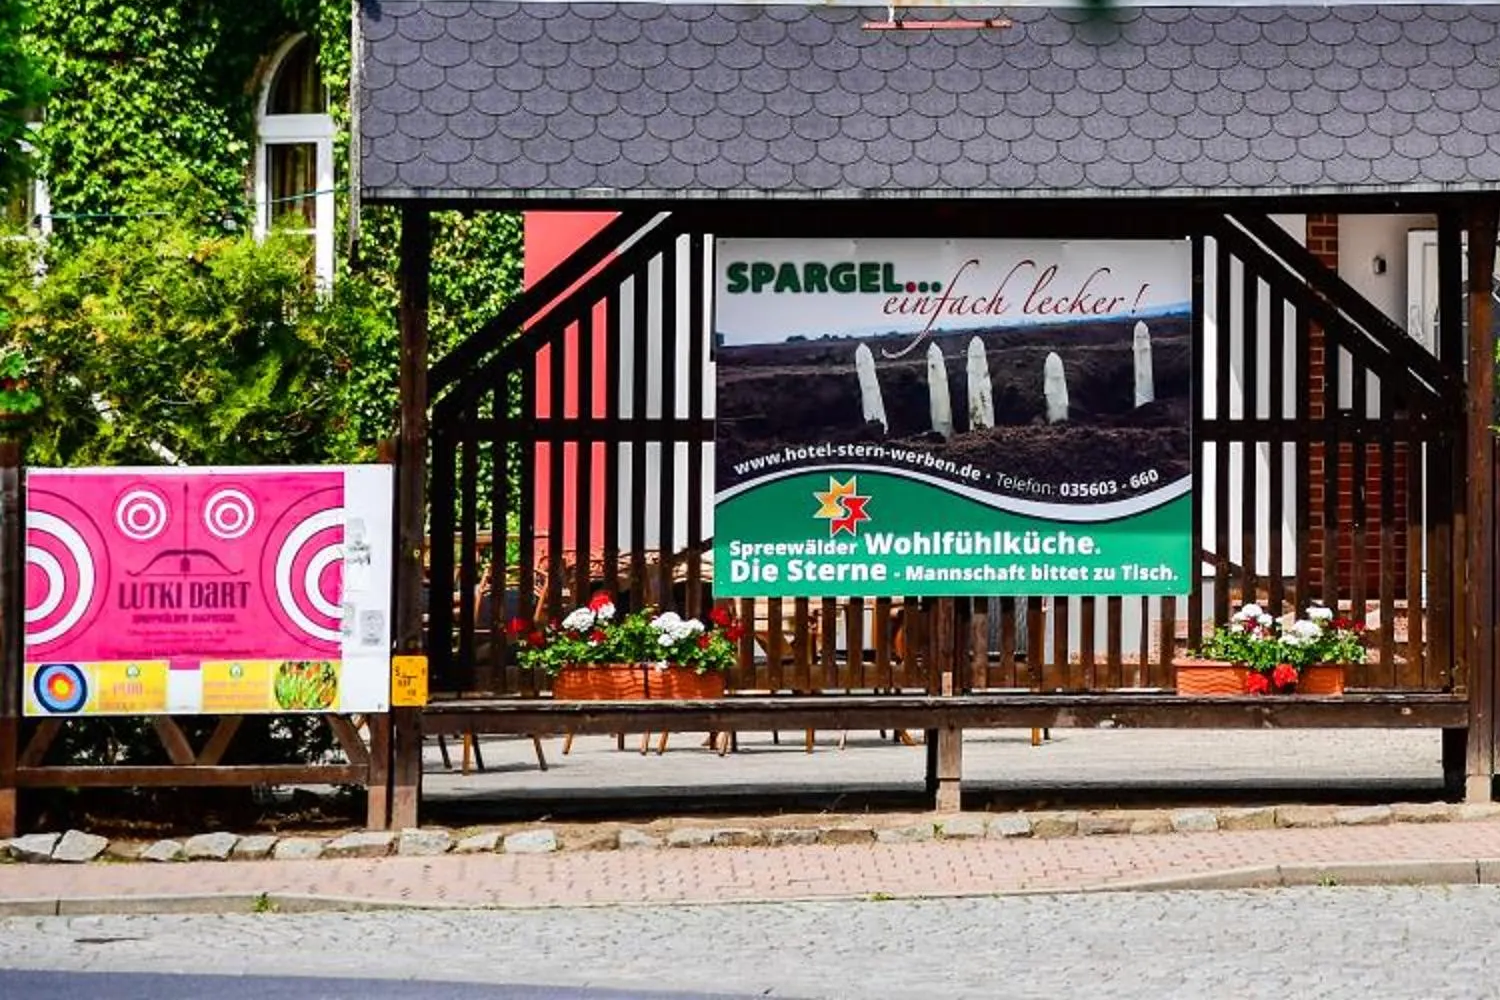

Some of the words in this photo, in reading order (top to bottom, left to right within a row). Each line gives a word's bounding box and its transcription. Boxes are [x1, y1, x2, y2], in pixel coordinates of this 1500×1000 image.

[727, 261, 942, 294] SPARGEL...
[882, 259, 1035, 358] einfach
[733, 442, 982, 480] www.hotel-stern-werben.de
[996, 471, 1056, 496] Telefon:
[1060, 479, 1117, 497] 035603
[1129, 469, 1159, 489] 660
[729, 539, 858, 559] Spreewälder
[864, 531, 1101, 555] Wohlfühlküche.
[730, 559, 779, 582] Die
[787, 559, 887, 582] Sterne
[905, 564, 1025, 581] Mannschaft
[1031, 564, 1089, 581] bittet
[1093, 566, 1115, 581] zu
[1121, 564, 1179, 581] Tisch.
[118, 581, 183, 610] LUTKI
